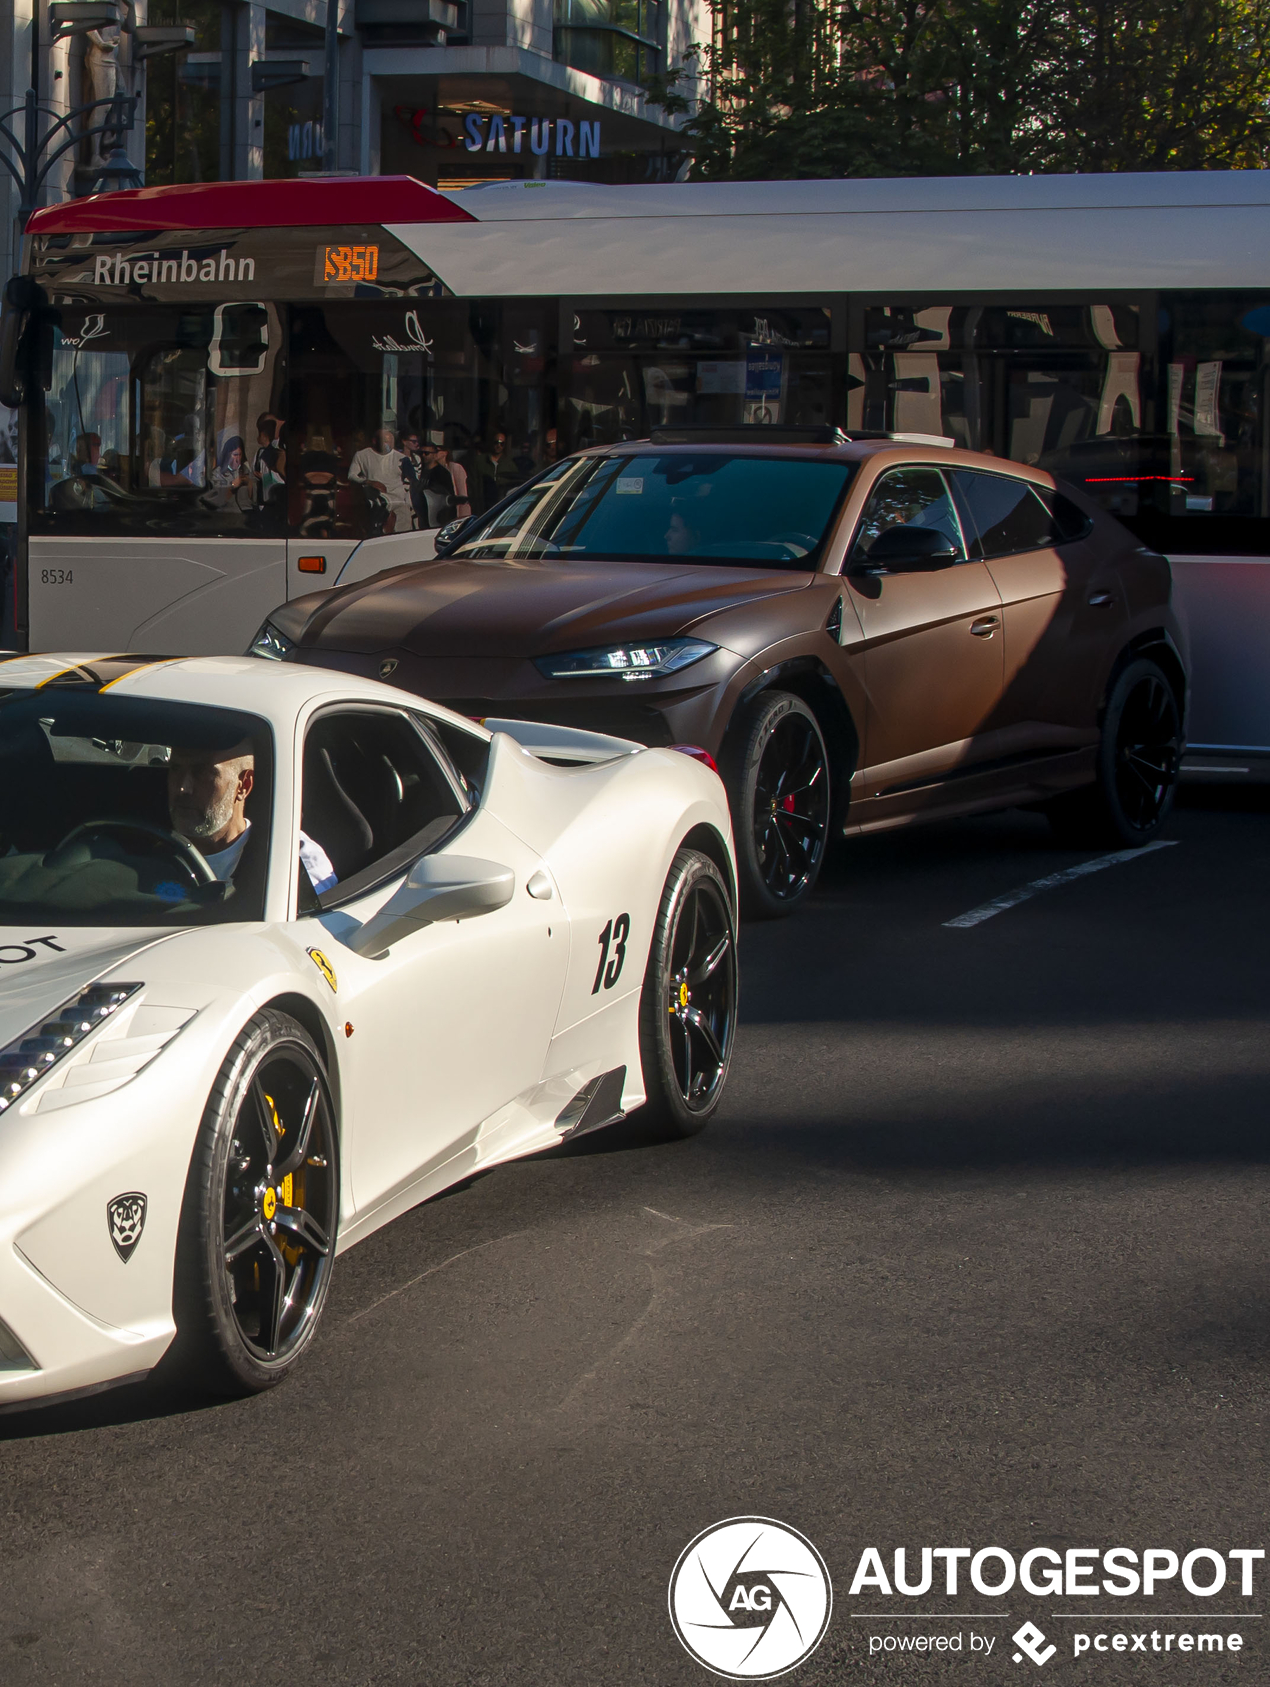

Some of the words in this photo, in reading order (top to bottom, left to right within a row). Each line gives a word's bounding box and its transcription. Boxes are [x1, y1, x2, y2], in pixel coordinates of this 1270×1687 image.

[463, 112, 601, 158] SATURN
[94, 249, 256, 285] Rheinbahn
[323, 245, 379, 281] SB50
[40, 568, 74, 585] 8534
[590, 911, 631, 996] 13
